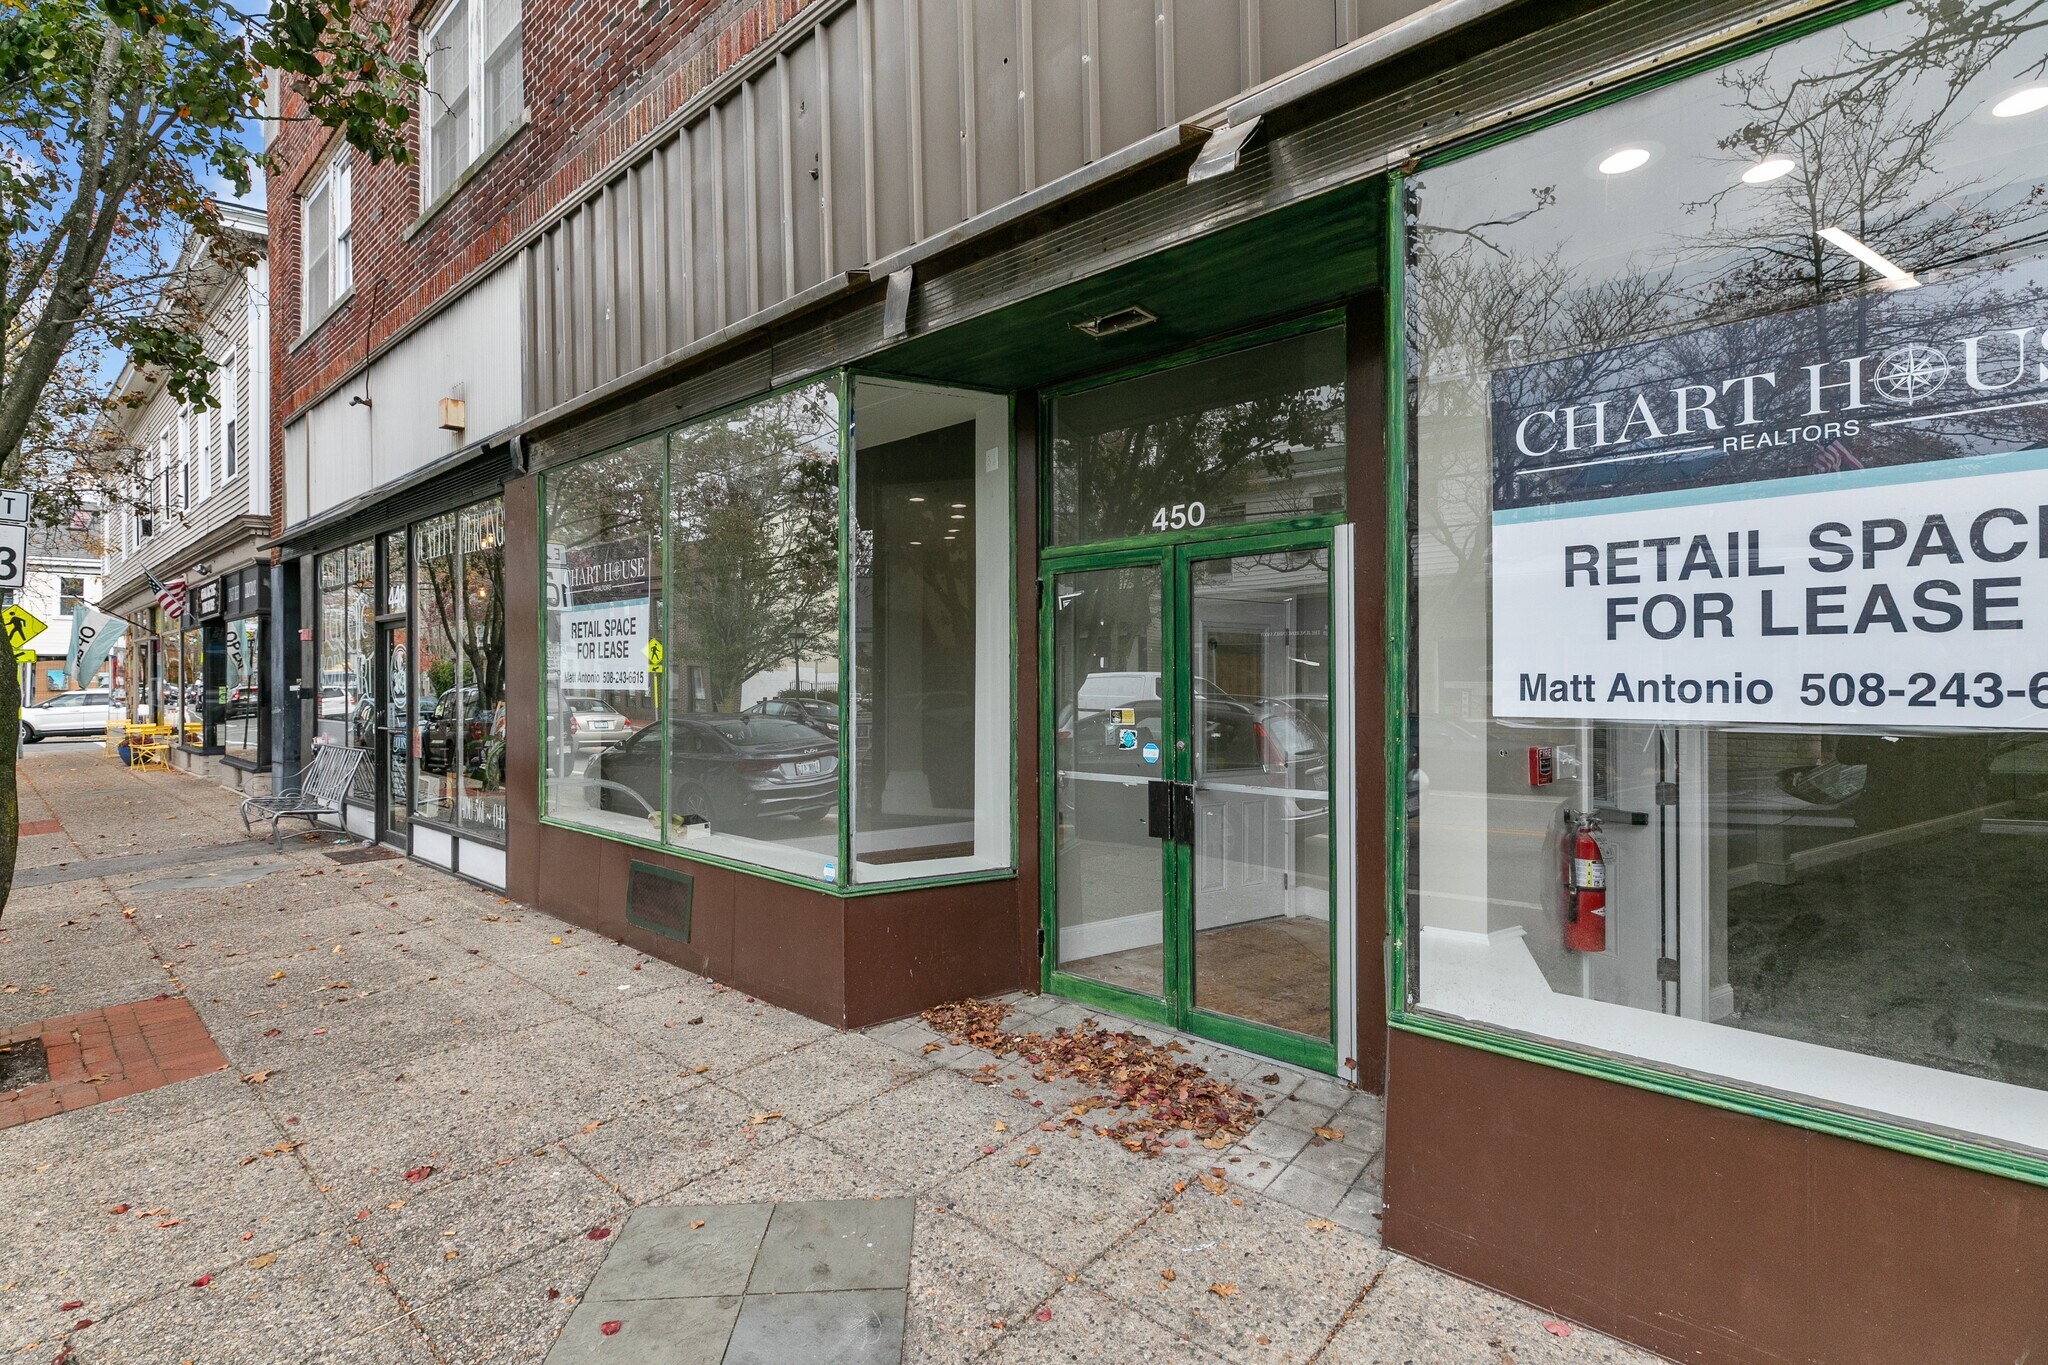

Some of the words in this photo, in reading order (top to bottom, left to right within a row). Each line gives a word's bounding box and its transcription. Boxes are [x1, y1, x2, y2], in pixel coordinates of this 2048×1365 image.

[1515, 372, 1776, 457] CHART
[1801, 327, 2048, 417] HOU
[1723, 420, 1860, 453] REALTORS
[1152, 501, 1206, 531] 450
[1564, 530, 1785, 588] RETAIL
[1808, 505, 2048, 573] SPAC
[564, 565, 601, 588] CHART
[604, 557, 645, 583] HOUSE
[388, 583, 406, 609] 446
[1606, 592, 1735, 641] FOR
[1761, 577, 2023, 637] LEASE
[571, 621, 602, 639] RETAIL
[604, 617, 636, 638] SPACE
[577, 642, 596, 660] FOR
[598, 640, 629, 659] LEASE
[578, 672, 600, 682] Antonio
[1519, 672, 1596, 702] Matt
[1606, 671, 1774, 704] Antonio
[1800, 671, 2048, 710] 508-243-6
[1539, 748, 1552, 758] FIRE
